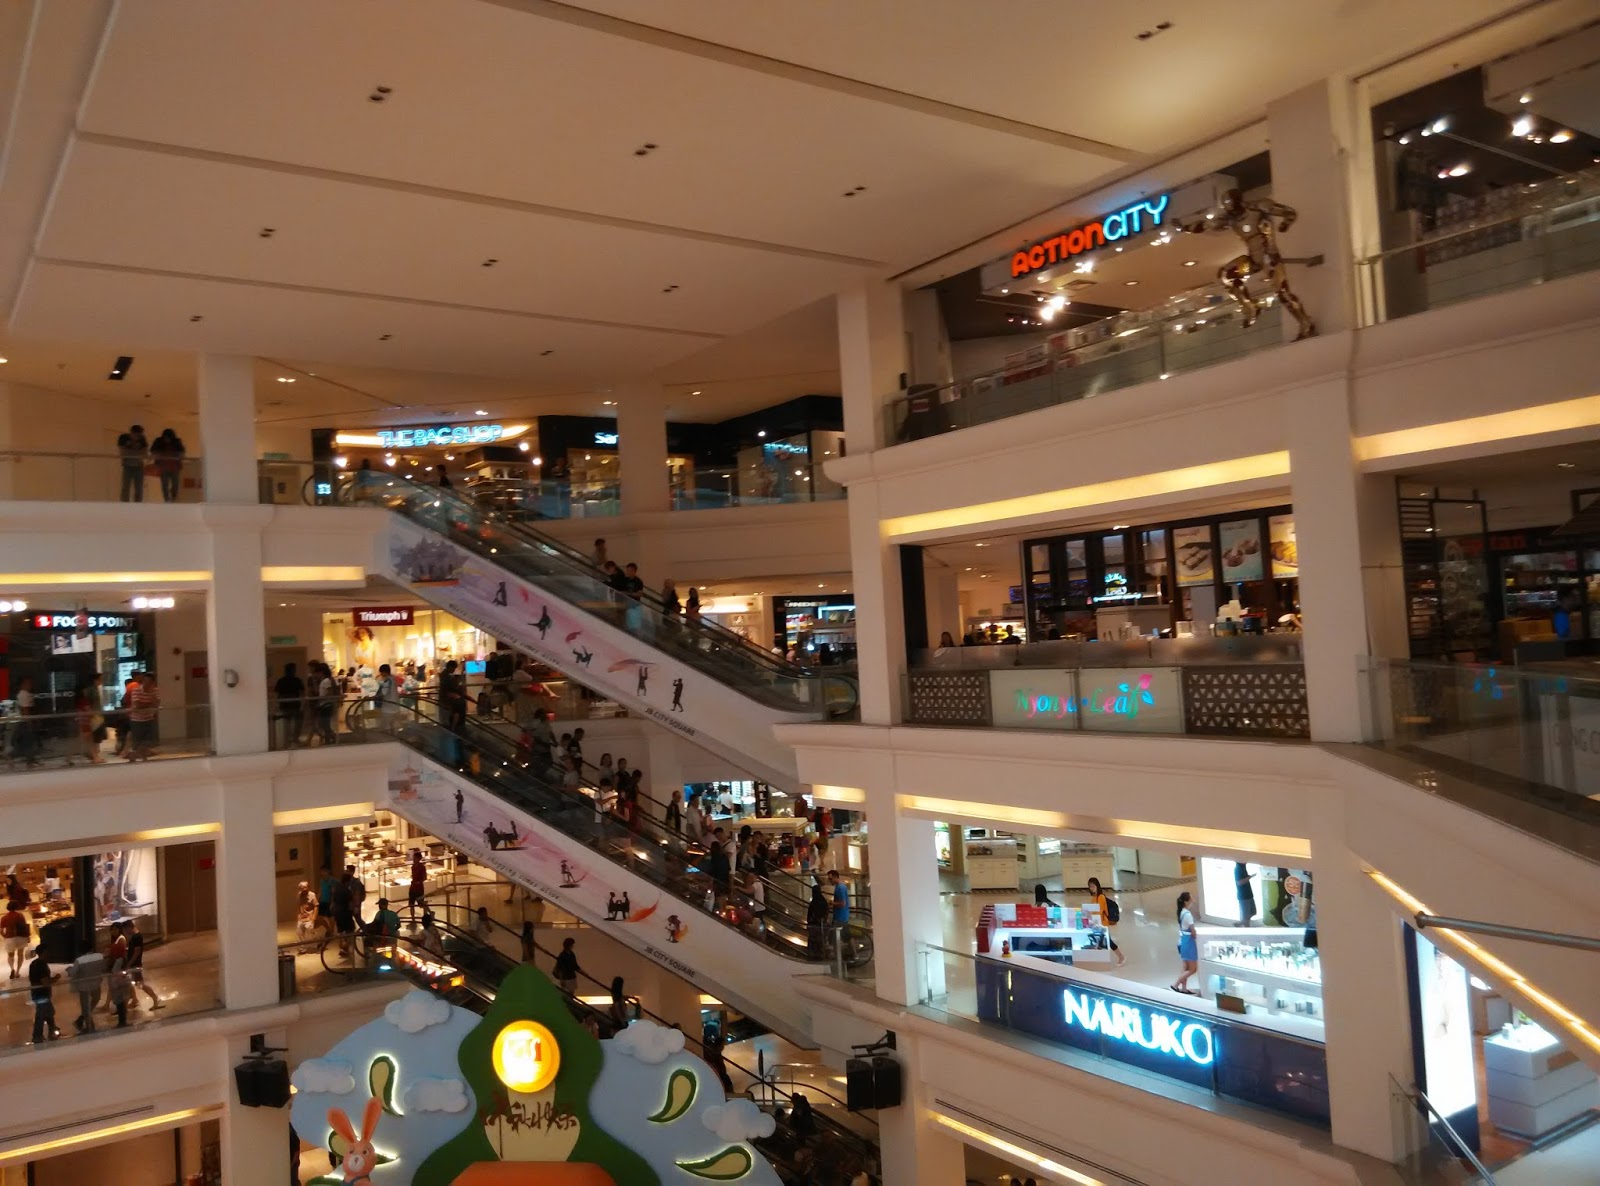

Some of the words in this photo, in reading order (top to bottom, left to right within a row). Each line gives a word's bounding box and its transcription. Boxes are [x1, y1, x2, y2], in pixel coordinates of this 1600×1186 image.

[376, 429, 415, 448] THE
[452, 424, 503, 444] SHOP
[52, 615, 97, 628] FOCS
[98, 616, 134, 628] POINT
[359, 611, 401, 623] Triumph
[1090, 683, 1141, 719] Leaf
[653, 711, 670, 721] CITY
[669, 719, 696, 737] SQUARE
[757, 781, 768, 816] KLEY
[653, 950, 669, 961] CITY
[668, 959, 696, 978] SQUARE
[1063, 989, 1214, 1065] NARUKO
